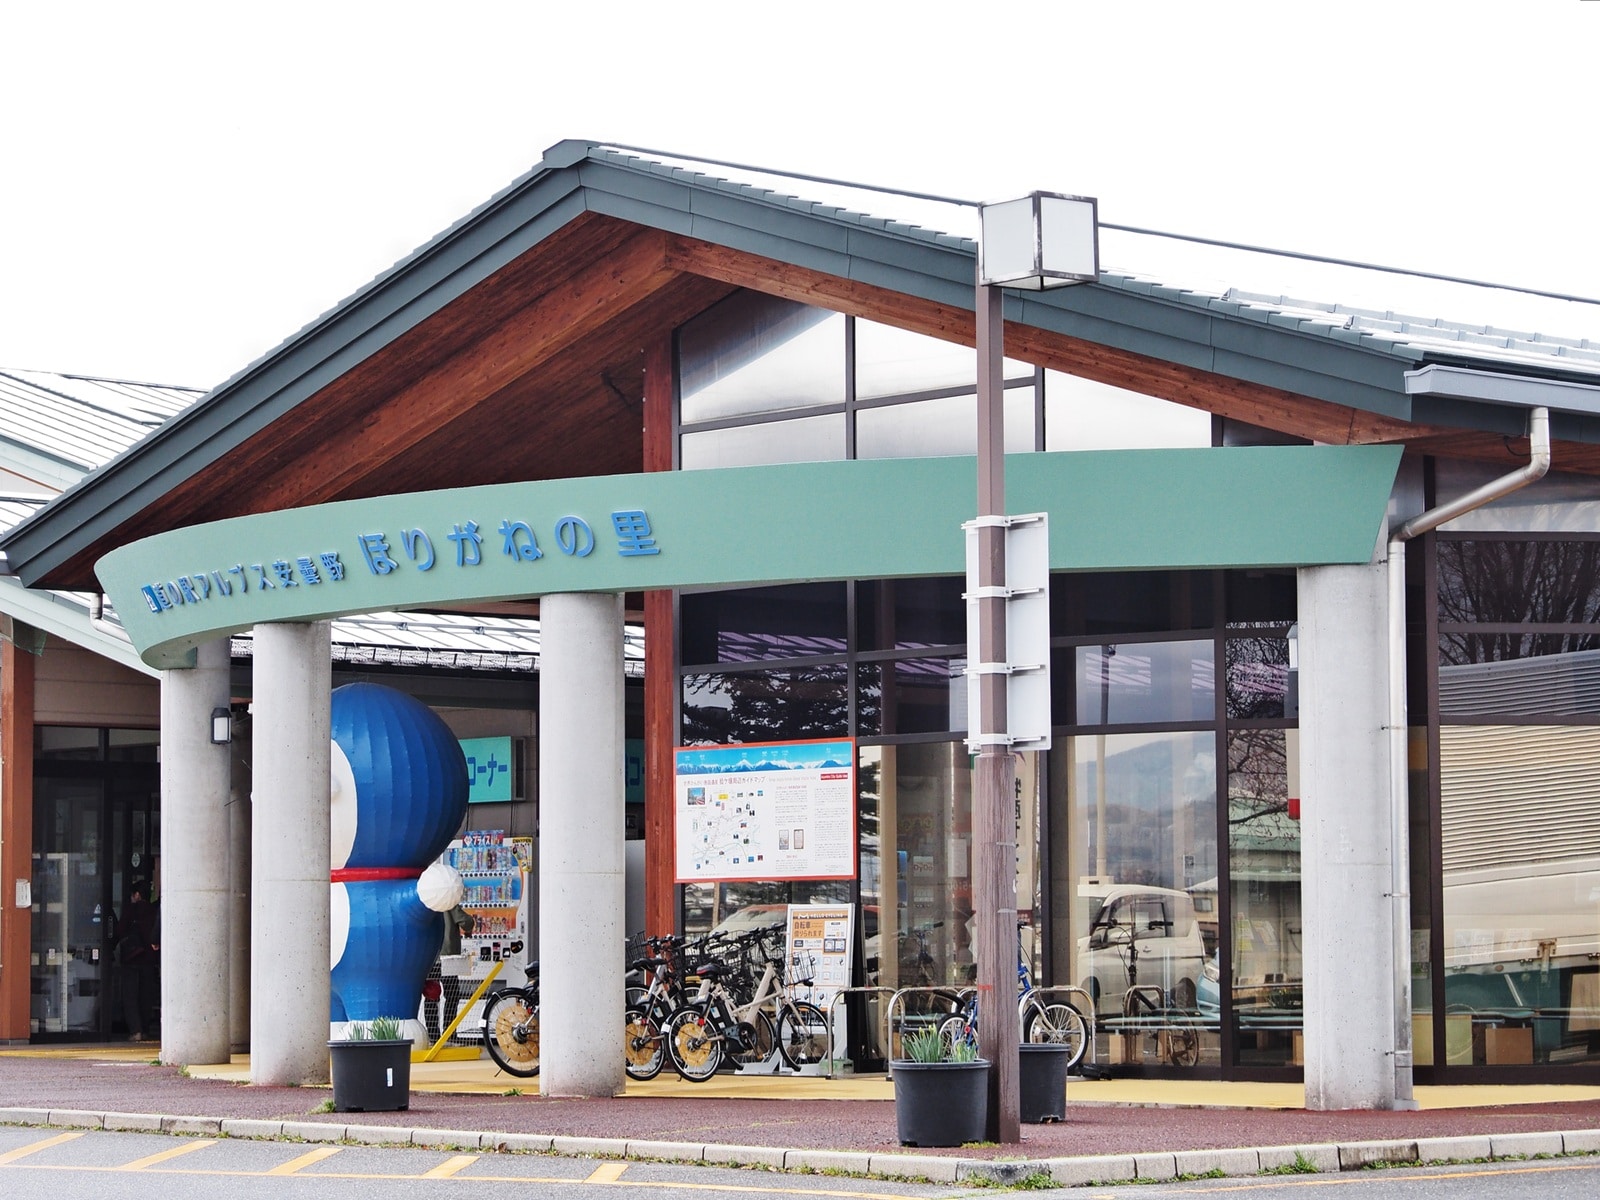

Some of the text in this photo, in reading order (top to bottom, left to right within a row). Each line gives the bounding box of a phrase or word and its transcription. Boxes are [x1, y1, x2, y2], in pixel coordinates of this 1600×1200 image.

[152, 509, 662, 609] 道の駅アルプス安曇野 ほりがねの里
[794, 921, 811, 930] 自転車
